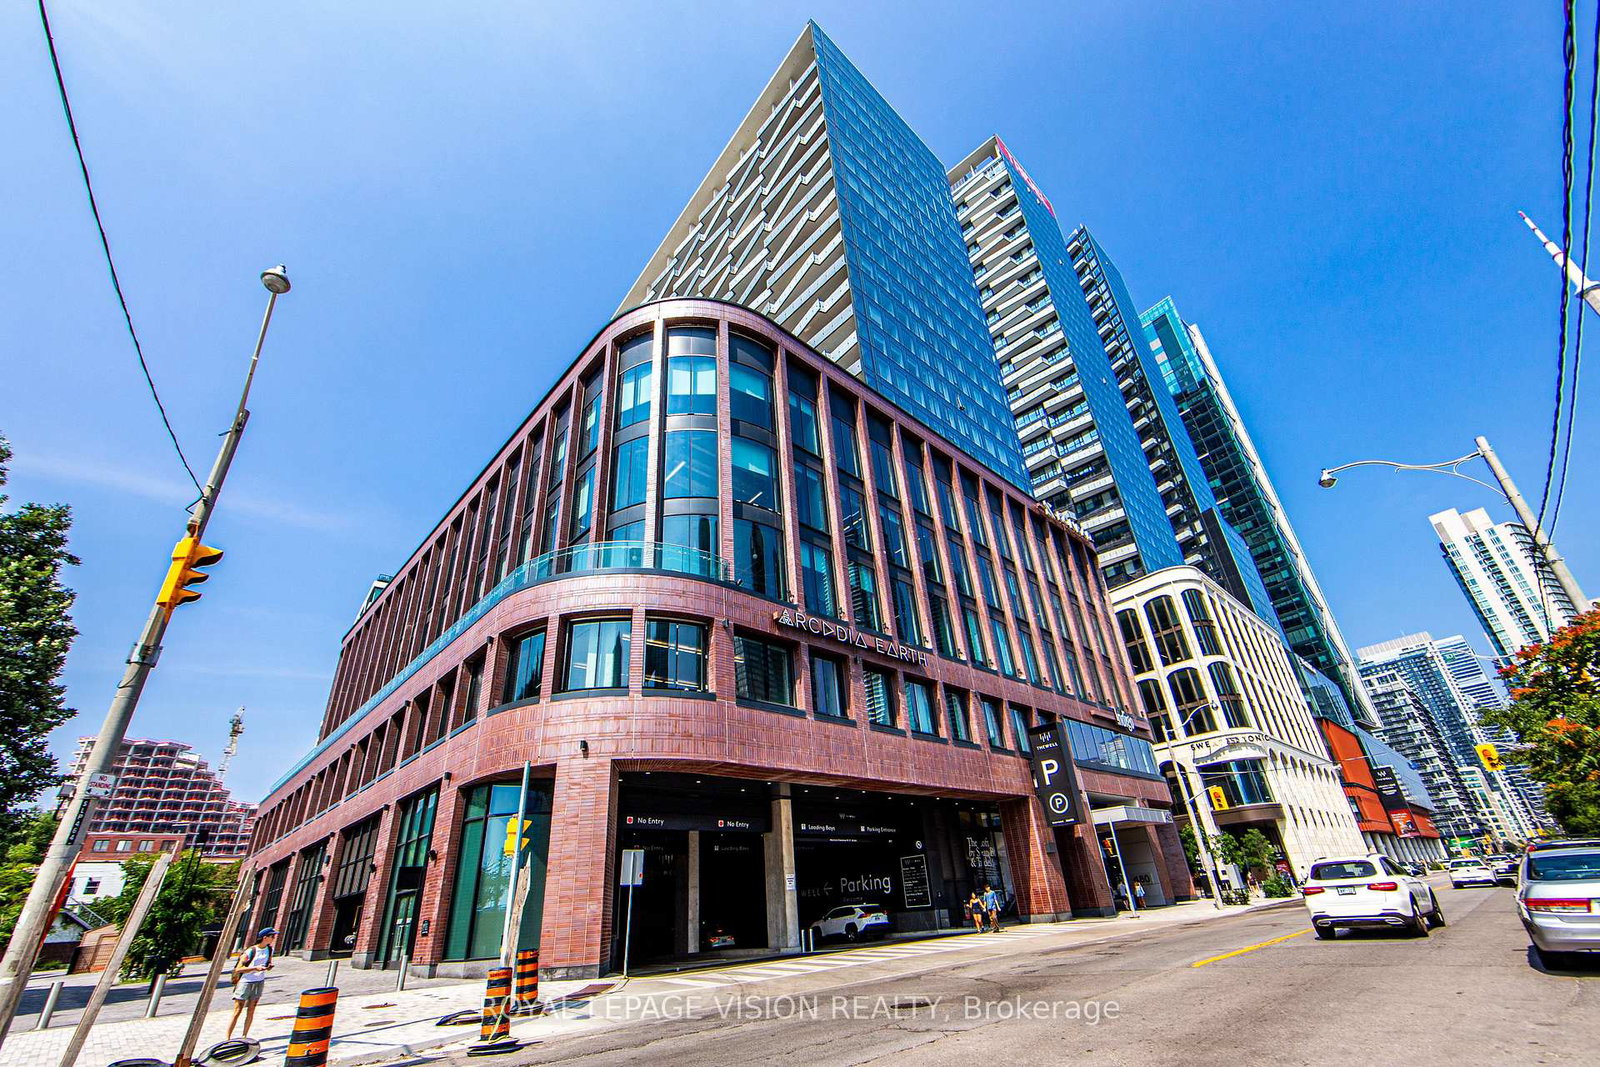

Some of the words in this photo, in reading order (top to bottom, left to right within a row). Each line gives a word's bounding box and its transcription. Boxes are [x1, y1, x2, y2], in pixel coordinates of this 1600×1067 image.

[778, 609, 868, 649] ARCADIA
[876, 637, 929, 667] EARTH
[1041, 759, 1059, 786] P
[90, 781, 112, 789] STANDING
[648, 817, 665, 827] Entry
[735, 821, 750, 829] Entry
[808, 824, 825, 832] Loading
[866, 826, 881, 834] Parking
[840, 873, 892, 894] Parking
